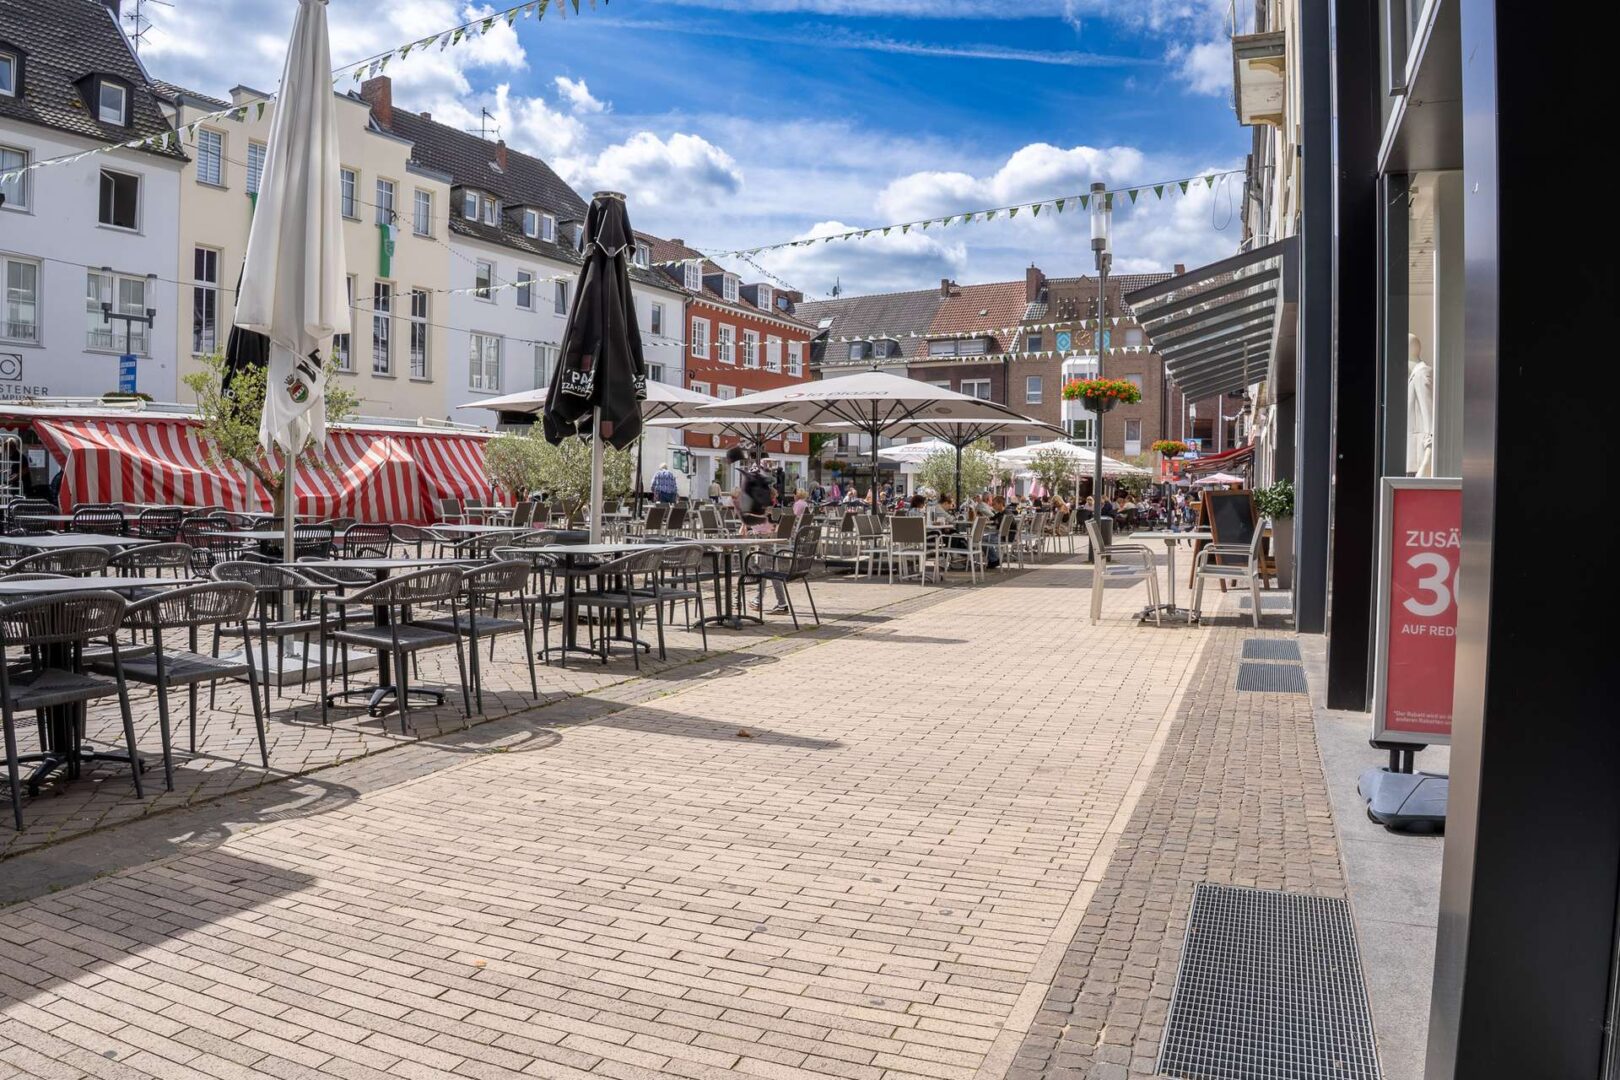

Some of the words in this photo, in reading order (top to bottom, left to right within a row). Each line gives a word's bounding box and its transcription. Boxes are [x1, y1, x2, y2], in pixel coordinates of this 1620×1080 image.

[1406, 528, 1461, 548] ZUSÄ
[1403, 552, 1460, 616] 3
[1401, 624, 1427, 635] AUF
[1429, 626, 1457, 637] RED
